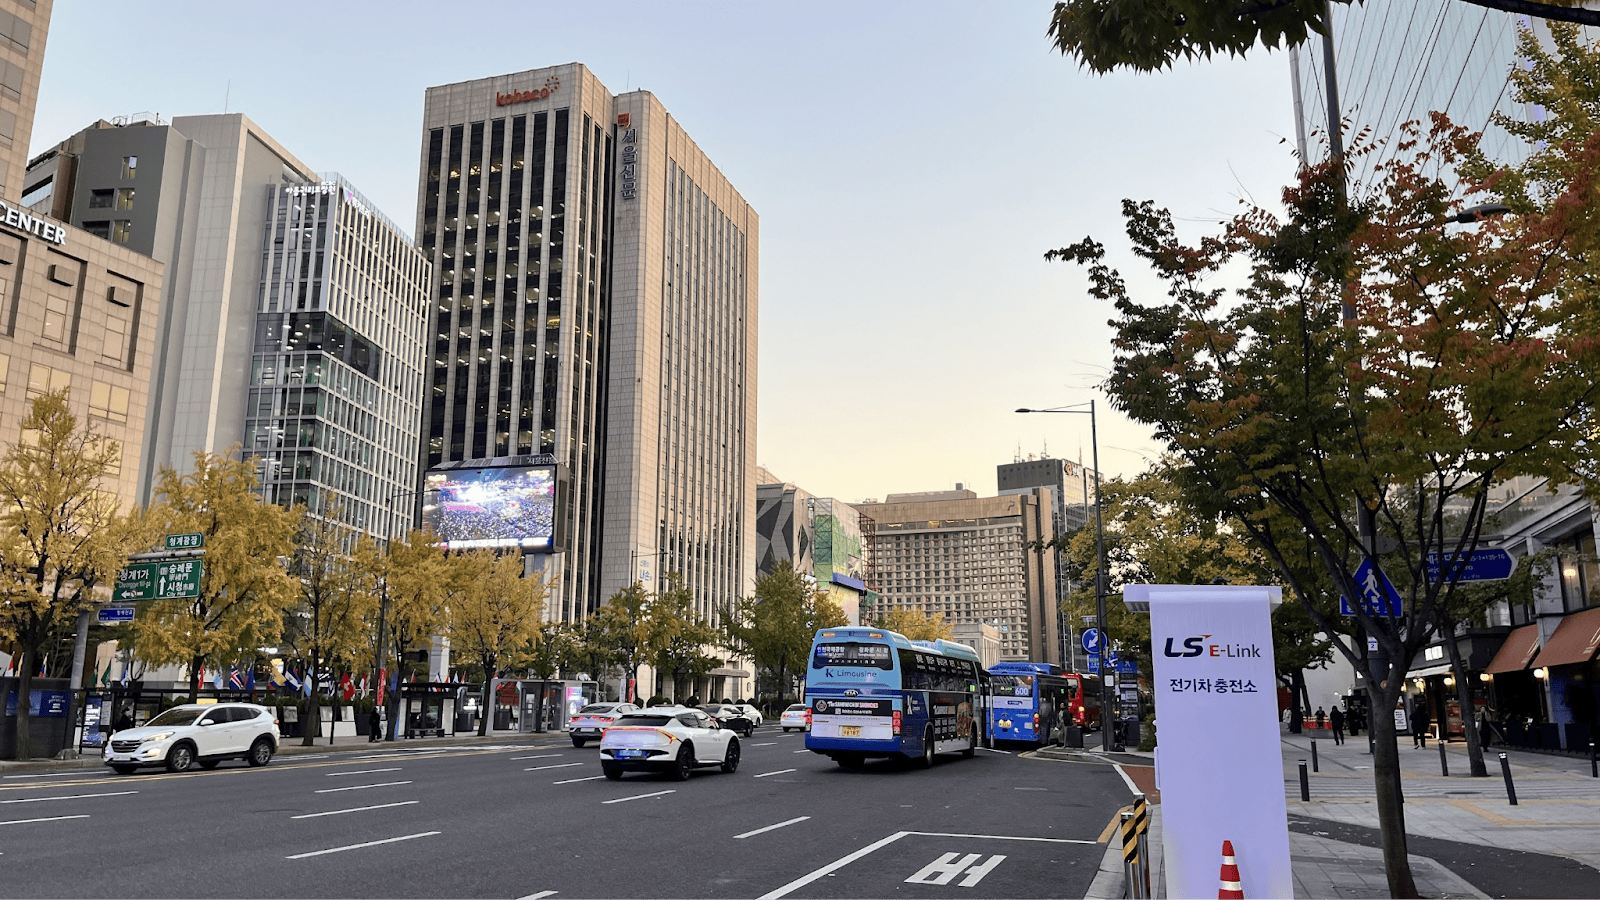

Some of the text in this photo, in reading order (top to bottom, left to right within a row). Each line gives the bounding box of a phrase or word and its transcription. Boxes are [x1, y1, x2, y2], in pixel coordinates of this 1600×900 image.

[496, 87, 550, 107] kobaco
[620, 128, 637, 200] 서울신문
[169, 536, 198, 546] 청계광장
[168, 562, 193, 574] 숭례문
[119, 569, 149, 581] 청계1가
[167, 581, 183, 592] 시청
[1164, 637, 1261, 658] LS E-Link
[837, 670, 877, 678] Limousine
[1014, 687, 1029, 696] 600
[1169, 678, 1258, 694] 전기차 충전소
